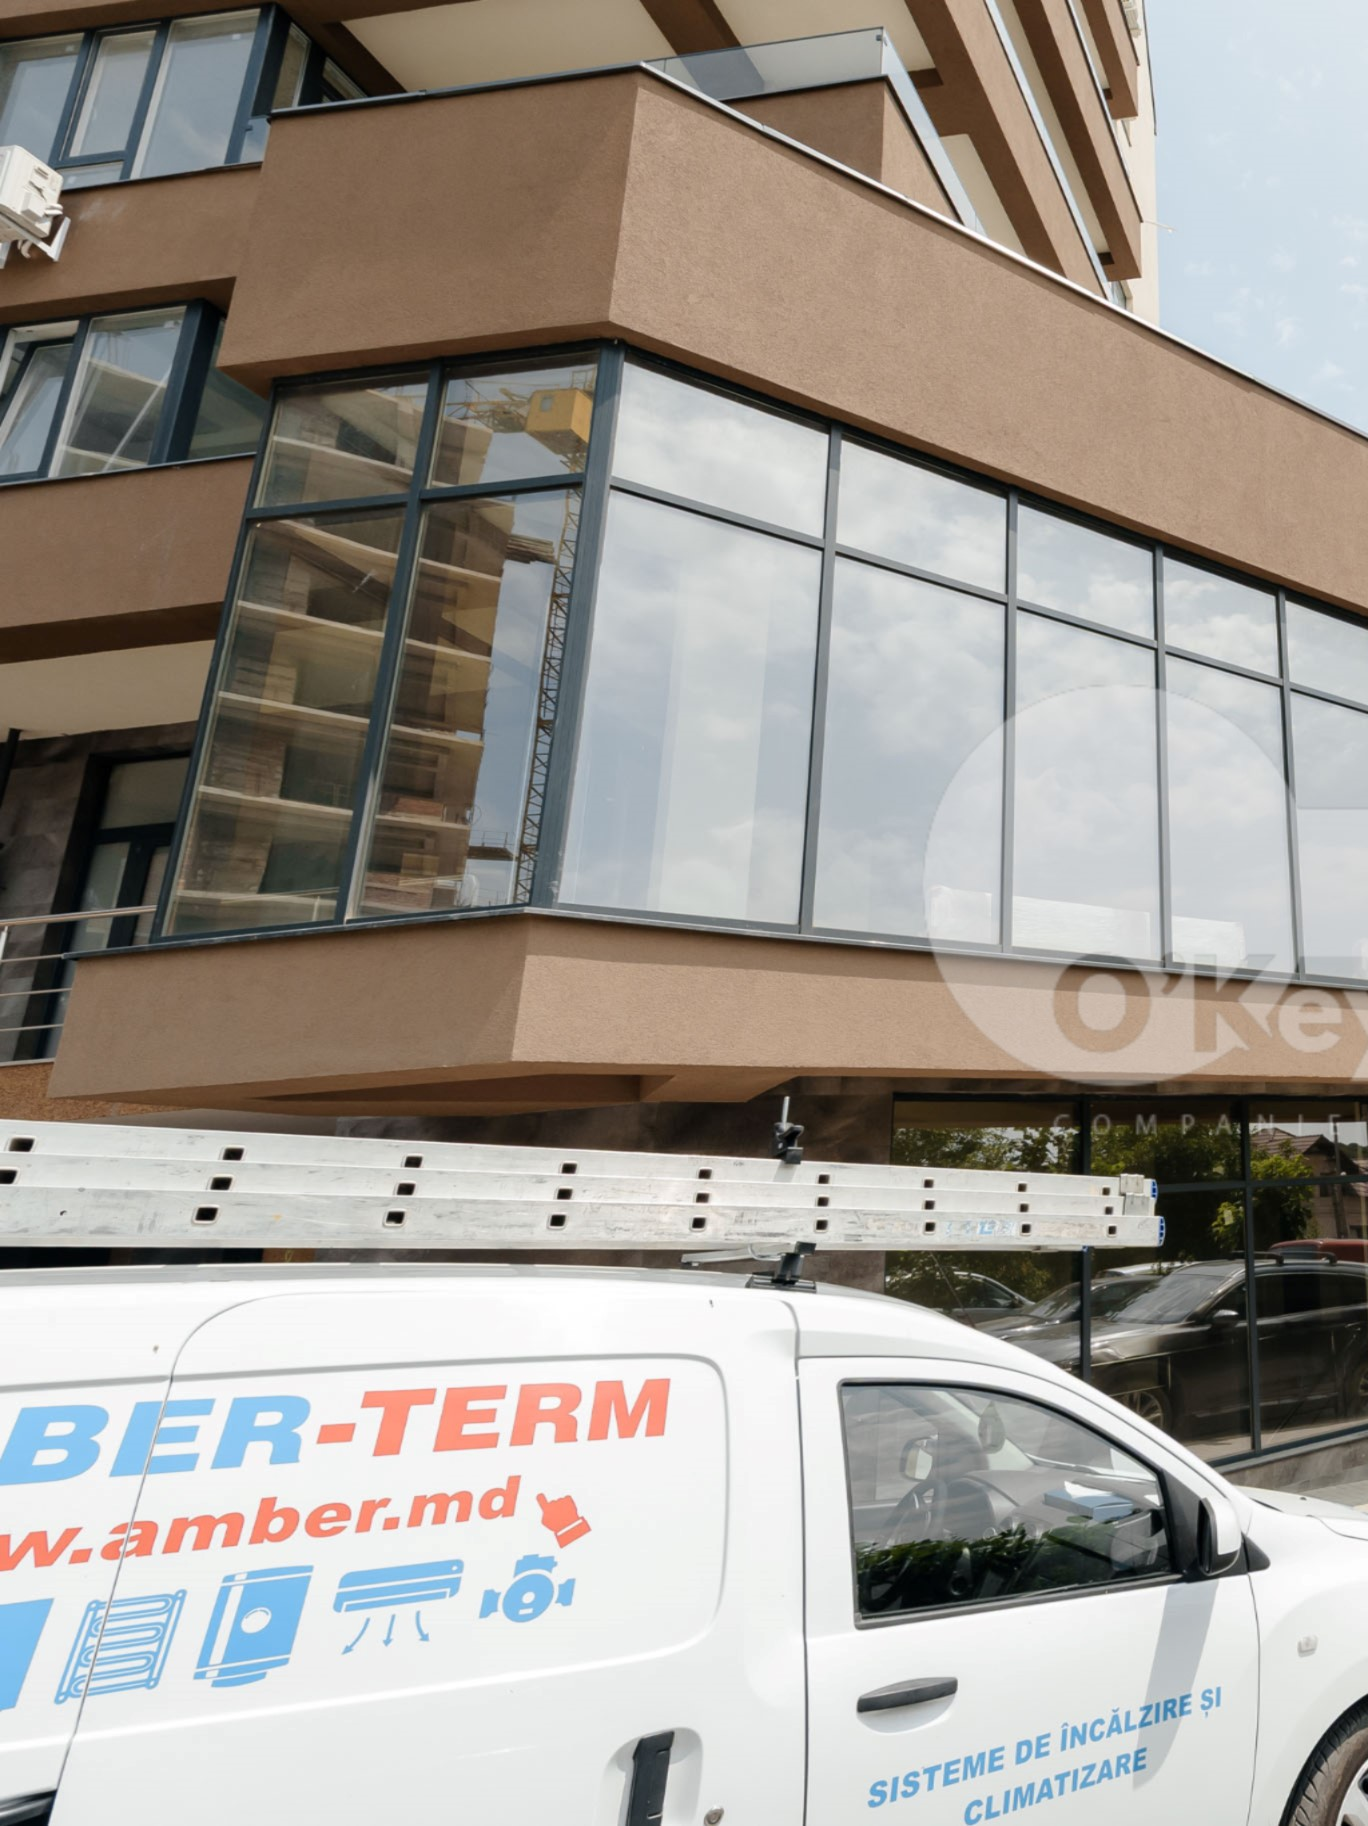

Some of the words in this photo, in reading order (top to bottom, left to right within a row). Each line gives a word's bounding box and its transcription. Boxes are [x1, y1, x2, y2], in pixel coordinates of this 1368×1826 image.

[867, 1747, 1005, 1808] SISTEME
[1015, 1733, 1051, 1765] DE
[1060, 1692, 1192, 1752] ÎNCĂLZIRE
[963, 1748, 1147, 1826] CLIMATIZARE
